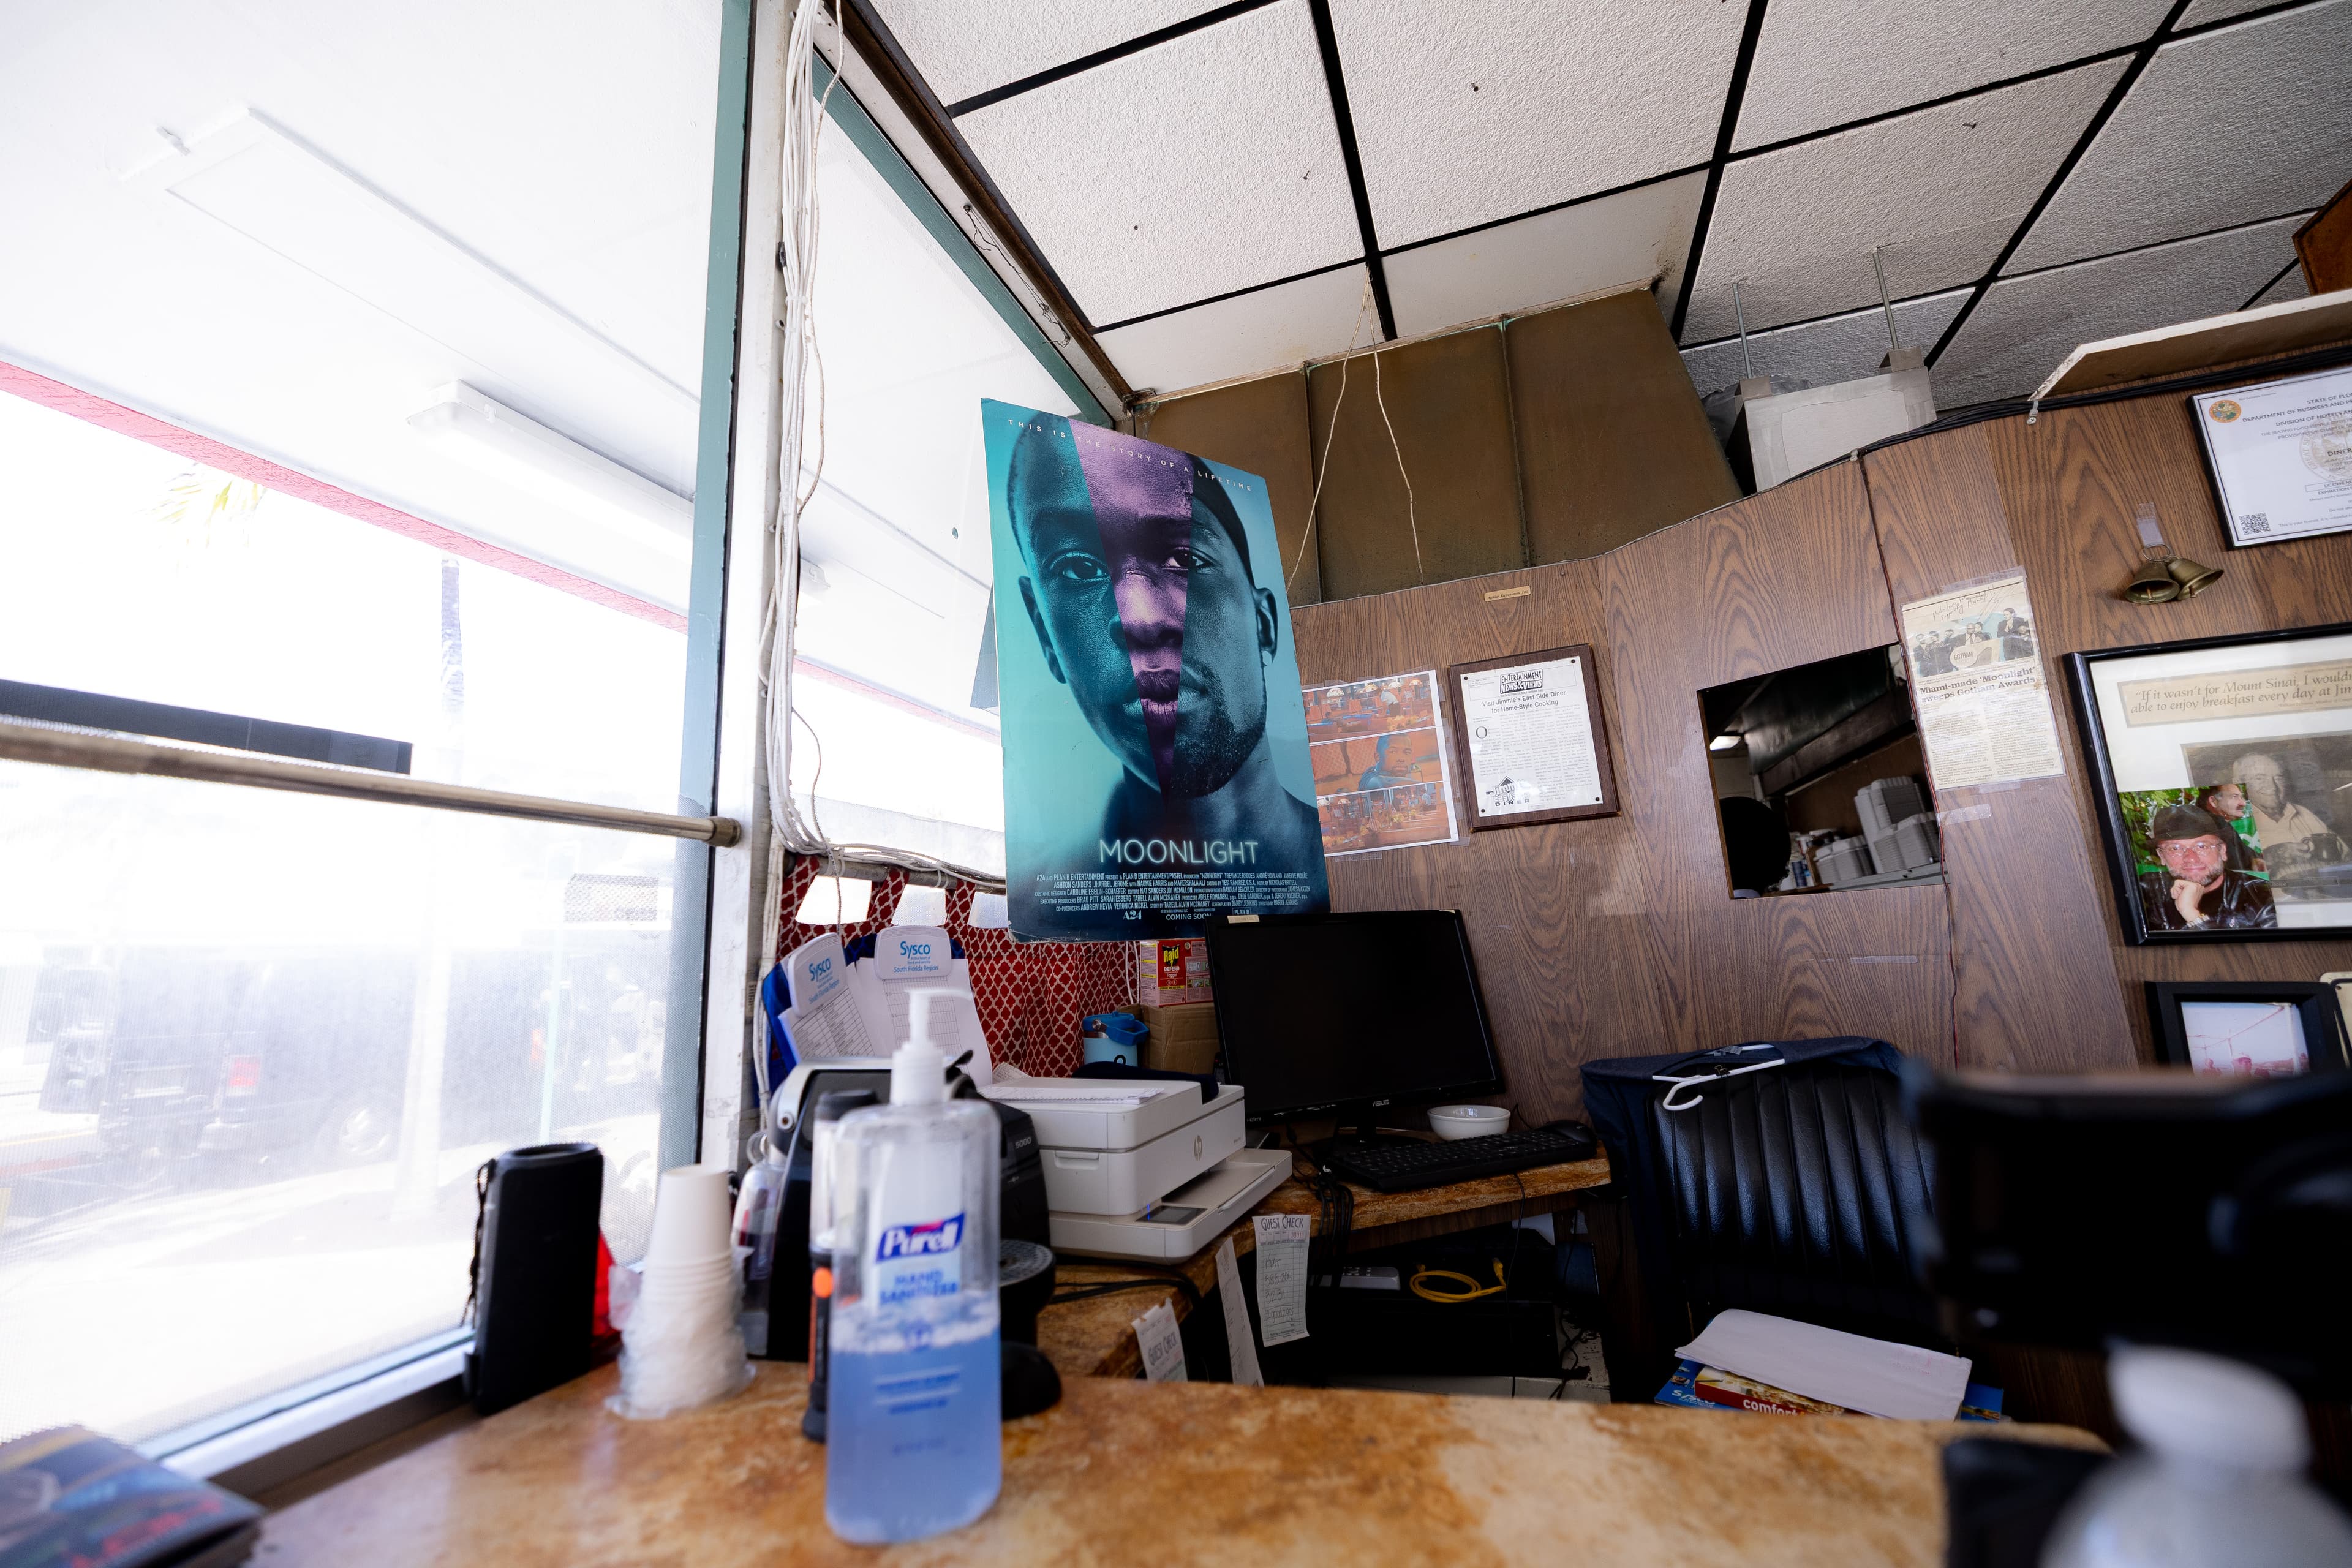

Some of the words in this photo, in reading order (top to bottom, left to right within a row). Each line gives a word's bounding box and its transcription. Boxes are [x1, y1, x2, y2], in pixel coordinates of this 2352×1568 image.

[2242, 411, 2286, 423] DEPARTMENT
[2297, 404, 2329, 413] BUSINESS
[2275, 418, 2305, 427] DIVISION
[2316, 411, 2343, 420] HOTELS
[1008, 419, 1042, 432] THIS
[1076, 436, 1101, 447] THE
[1111, 446, 1151, 461] STORY
[1198, 470, 1251, 491] LIFETIME
[2328, 448, 2352, 457] DINER
[1954, 651, 1973, 661] GOTHAM
[1501, 671, 1542, 684] ENTERTAINMENT
[1920, 678, 1978, 695] Miami-made
[1980, 666, 2035, 683] 'Moonlight'
[1922, 692, 1955, 703] sweeps
[1957, 684, 1996, 696] Gotham
[1998, 676, 2035, 688] Awards
[2154, 690, 2160, 699] it
[2164, 685, 2201, 699] wasn't
[2204, 684, 2220, 698] for
[2223, 681, 2262, 693] Mount
[2304, 674, 2308, 685] I
[1496, 697, 1521, 706] Jimmie's
[1501, 703, 1533, 712] Home-Style
[2132, 702, 2153, 714] able
[2169, 699, 2199, 711] enjoy
[2203, 693, 2255, 707] breakfast
[2258, 692, 2289, 703] every
[2292, 687, 2315, 699] day
[2318, 687, 2331, 696] at
[1476, 726, 1488, 739] O
[1099, 839, 1259, 864] MOONLIGHT
[1123, 910, 1142, 920] A24
[900, 941, 931, 959] Sysco
[1164, 947, 1179, 963] Raid
[809, 958, 831, 982] Sysco
[1015, 1136, 1031, 1149] 5000
[1261, 1218, 1280, 1231] GUEST
[1282, 1215, 1304, 1229] CHECK
